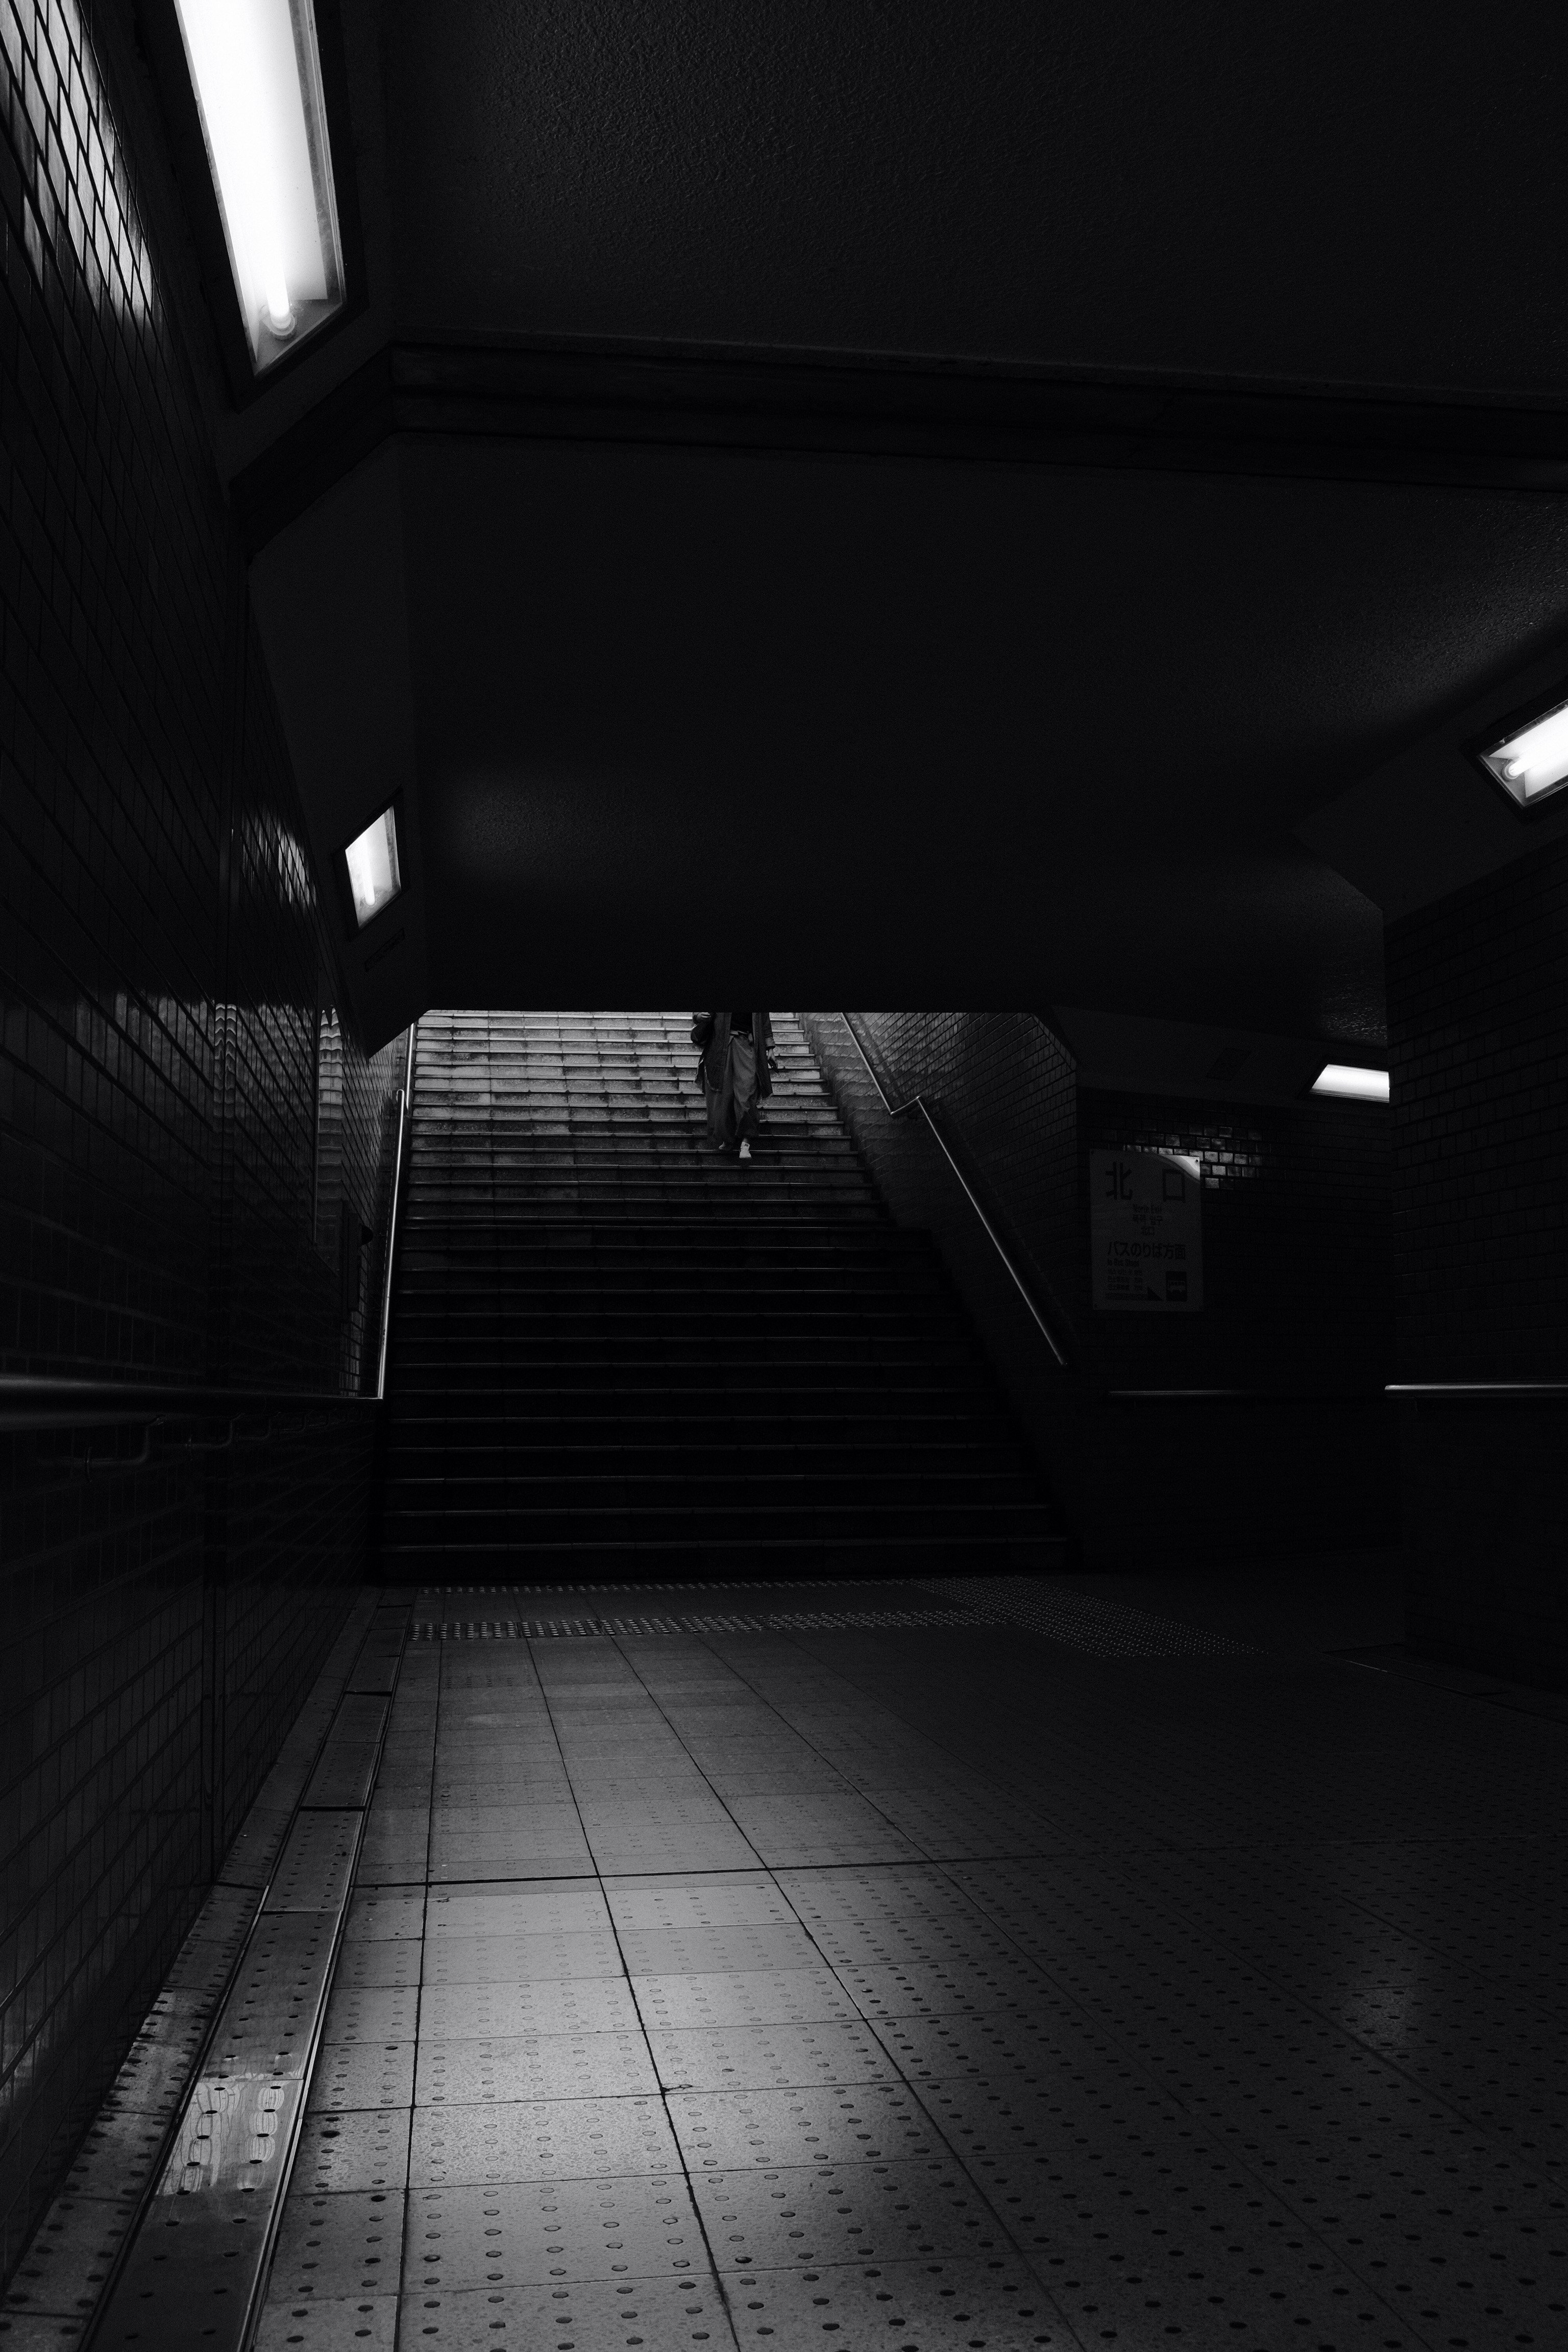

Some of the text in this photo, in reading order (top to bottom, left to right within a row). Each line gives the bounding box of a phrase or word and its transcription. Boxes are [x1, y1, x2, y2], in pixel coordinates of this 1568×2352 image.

[1105, 1162, 1185, 1203] 北口
[1108, 1241, 1186, 1260] バスのりば方面
